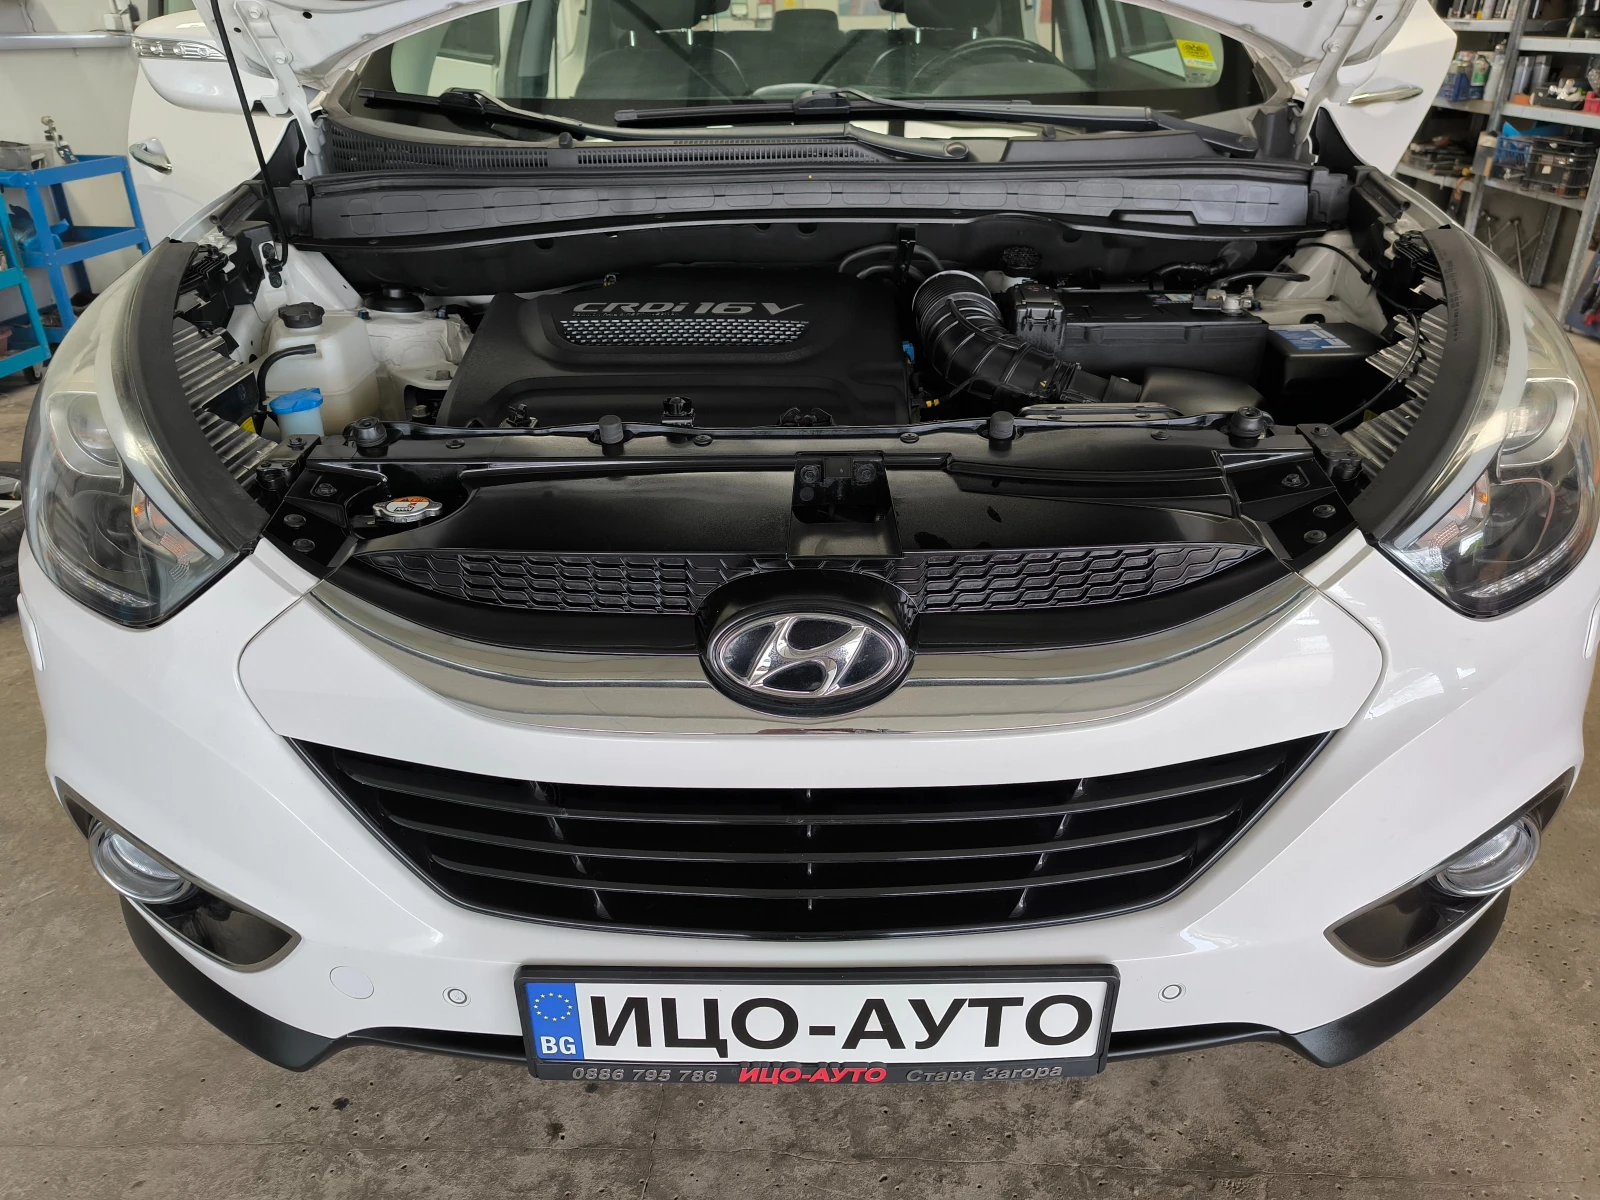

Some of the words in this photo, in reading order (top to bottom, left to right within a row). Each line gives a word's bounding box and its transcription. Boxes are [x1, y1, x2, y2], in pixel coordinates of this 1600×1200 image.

[573, 302, 689, 313] CRDi
[590, 994, 1093, 1059] ИЦО-АУТО
[540, 1036, 577, 1055] BG
[572, 1067, 625, 1081] 0886
[632, 1069, 671, 1082] 795
[679, 1070, 718, 1083] 786
[738, 1066, 887, 1085] ИЦО-АУТО
[906, 1068, 976, 1083] Стара
[983, 1066, 1063, 1081] Загора
